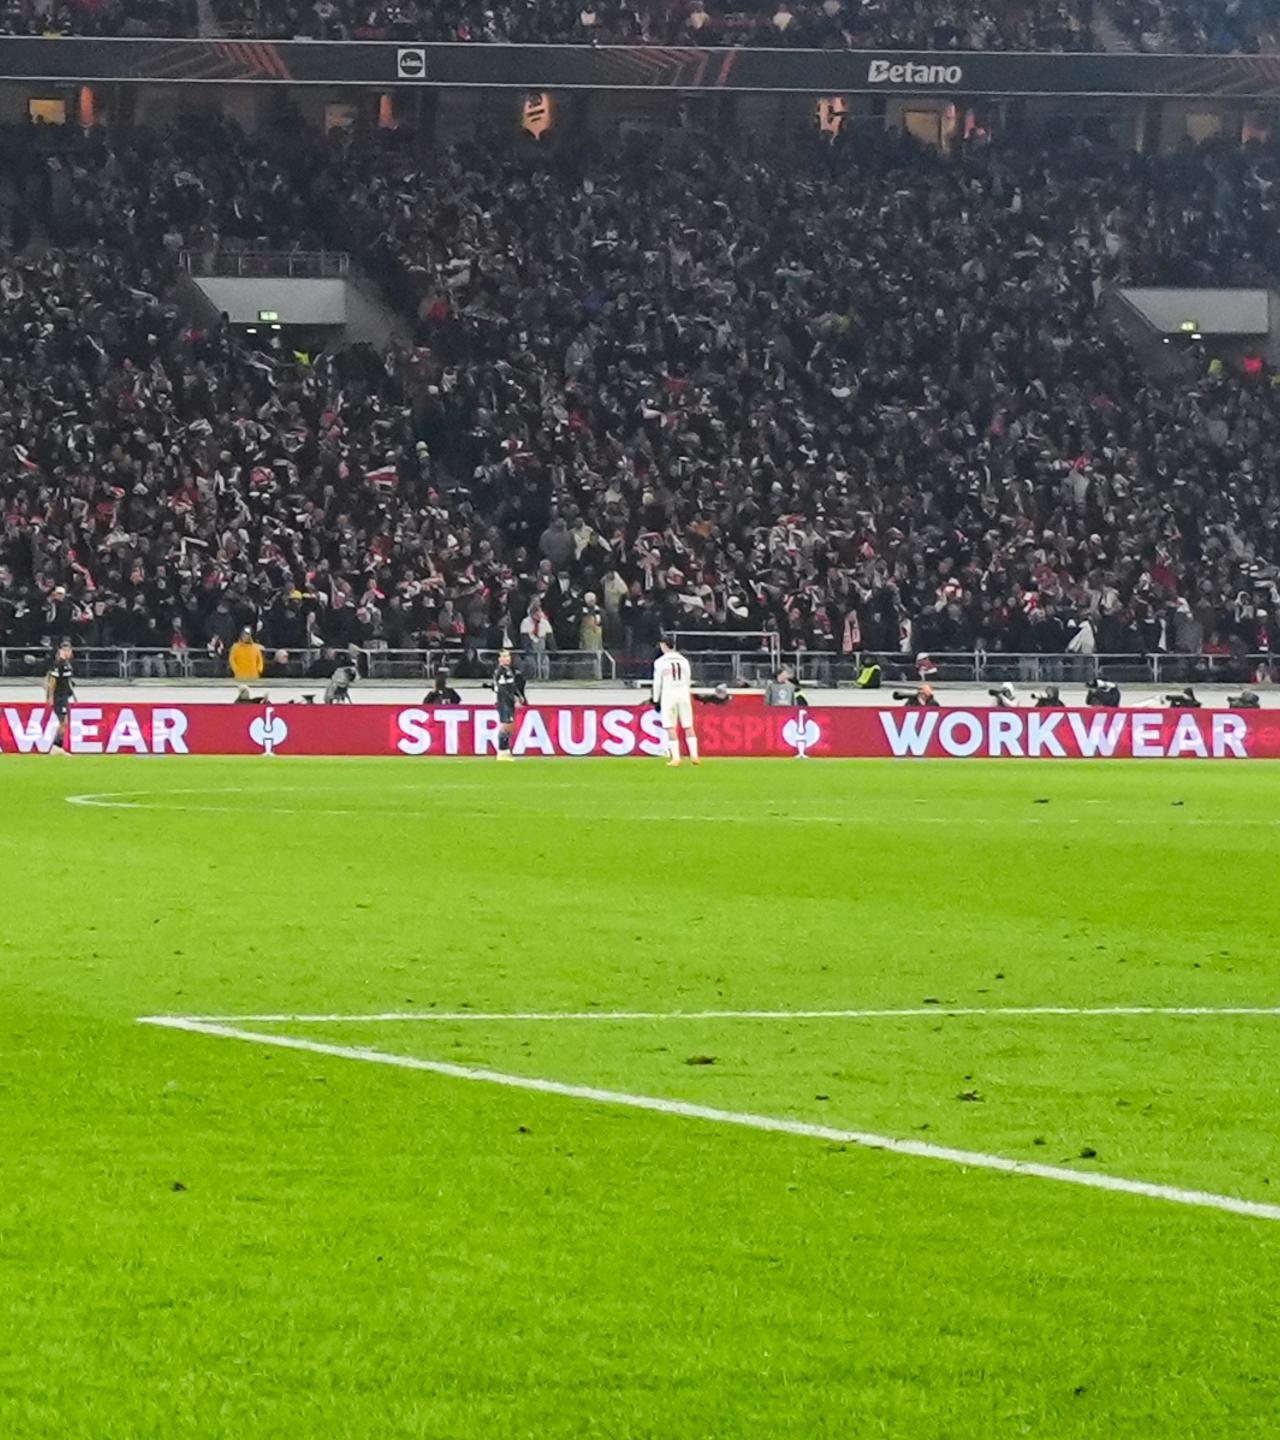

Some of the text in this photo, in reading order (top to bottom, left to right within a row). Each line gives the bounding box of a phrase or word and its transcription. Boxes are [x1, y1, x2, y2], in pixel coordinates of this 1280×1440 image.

[867, 60, 963, 85] Betano
[670, 662, 682, 681] 11
[397, 709, 668, 755] STRAUSS
[878, 710, 1248, 758] WORKWEAR
